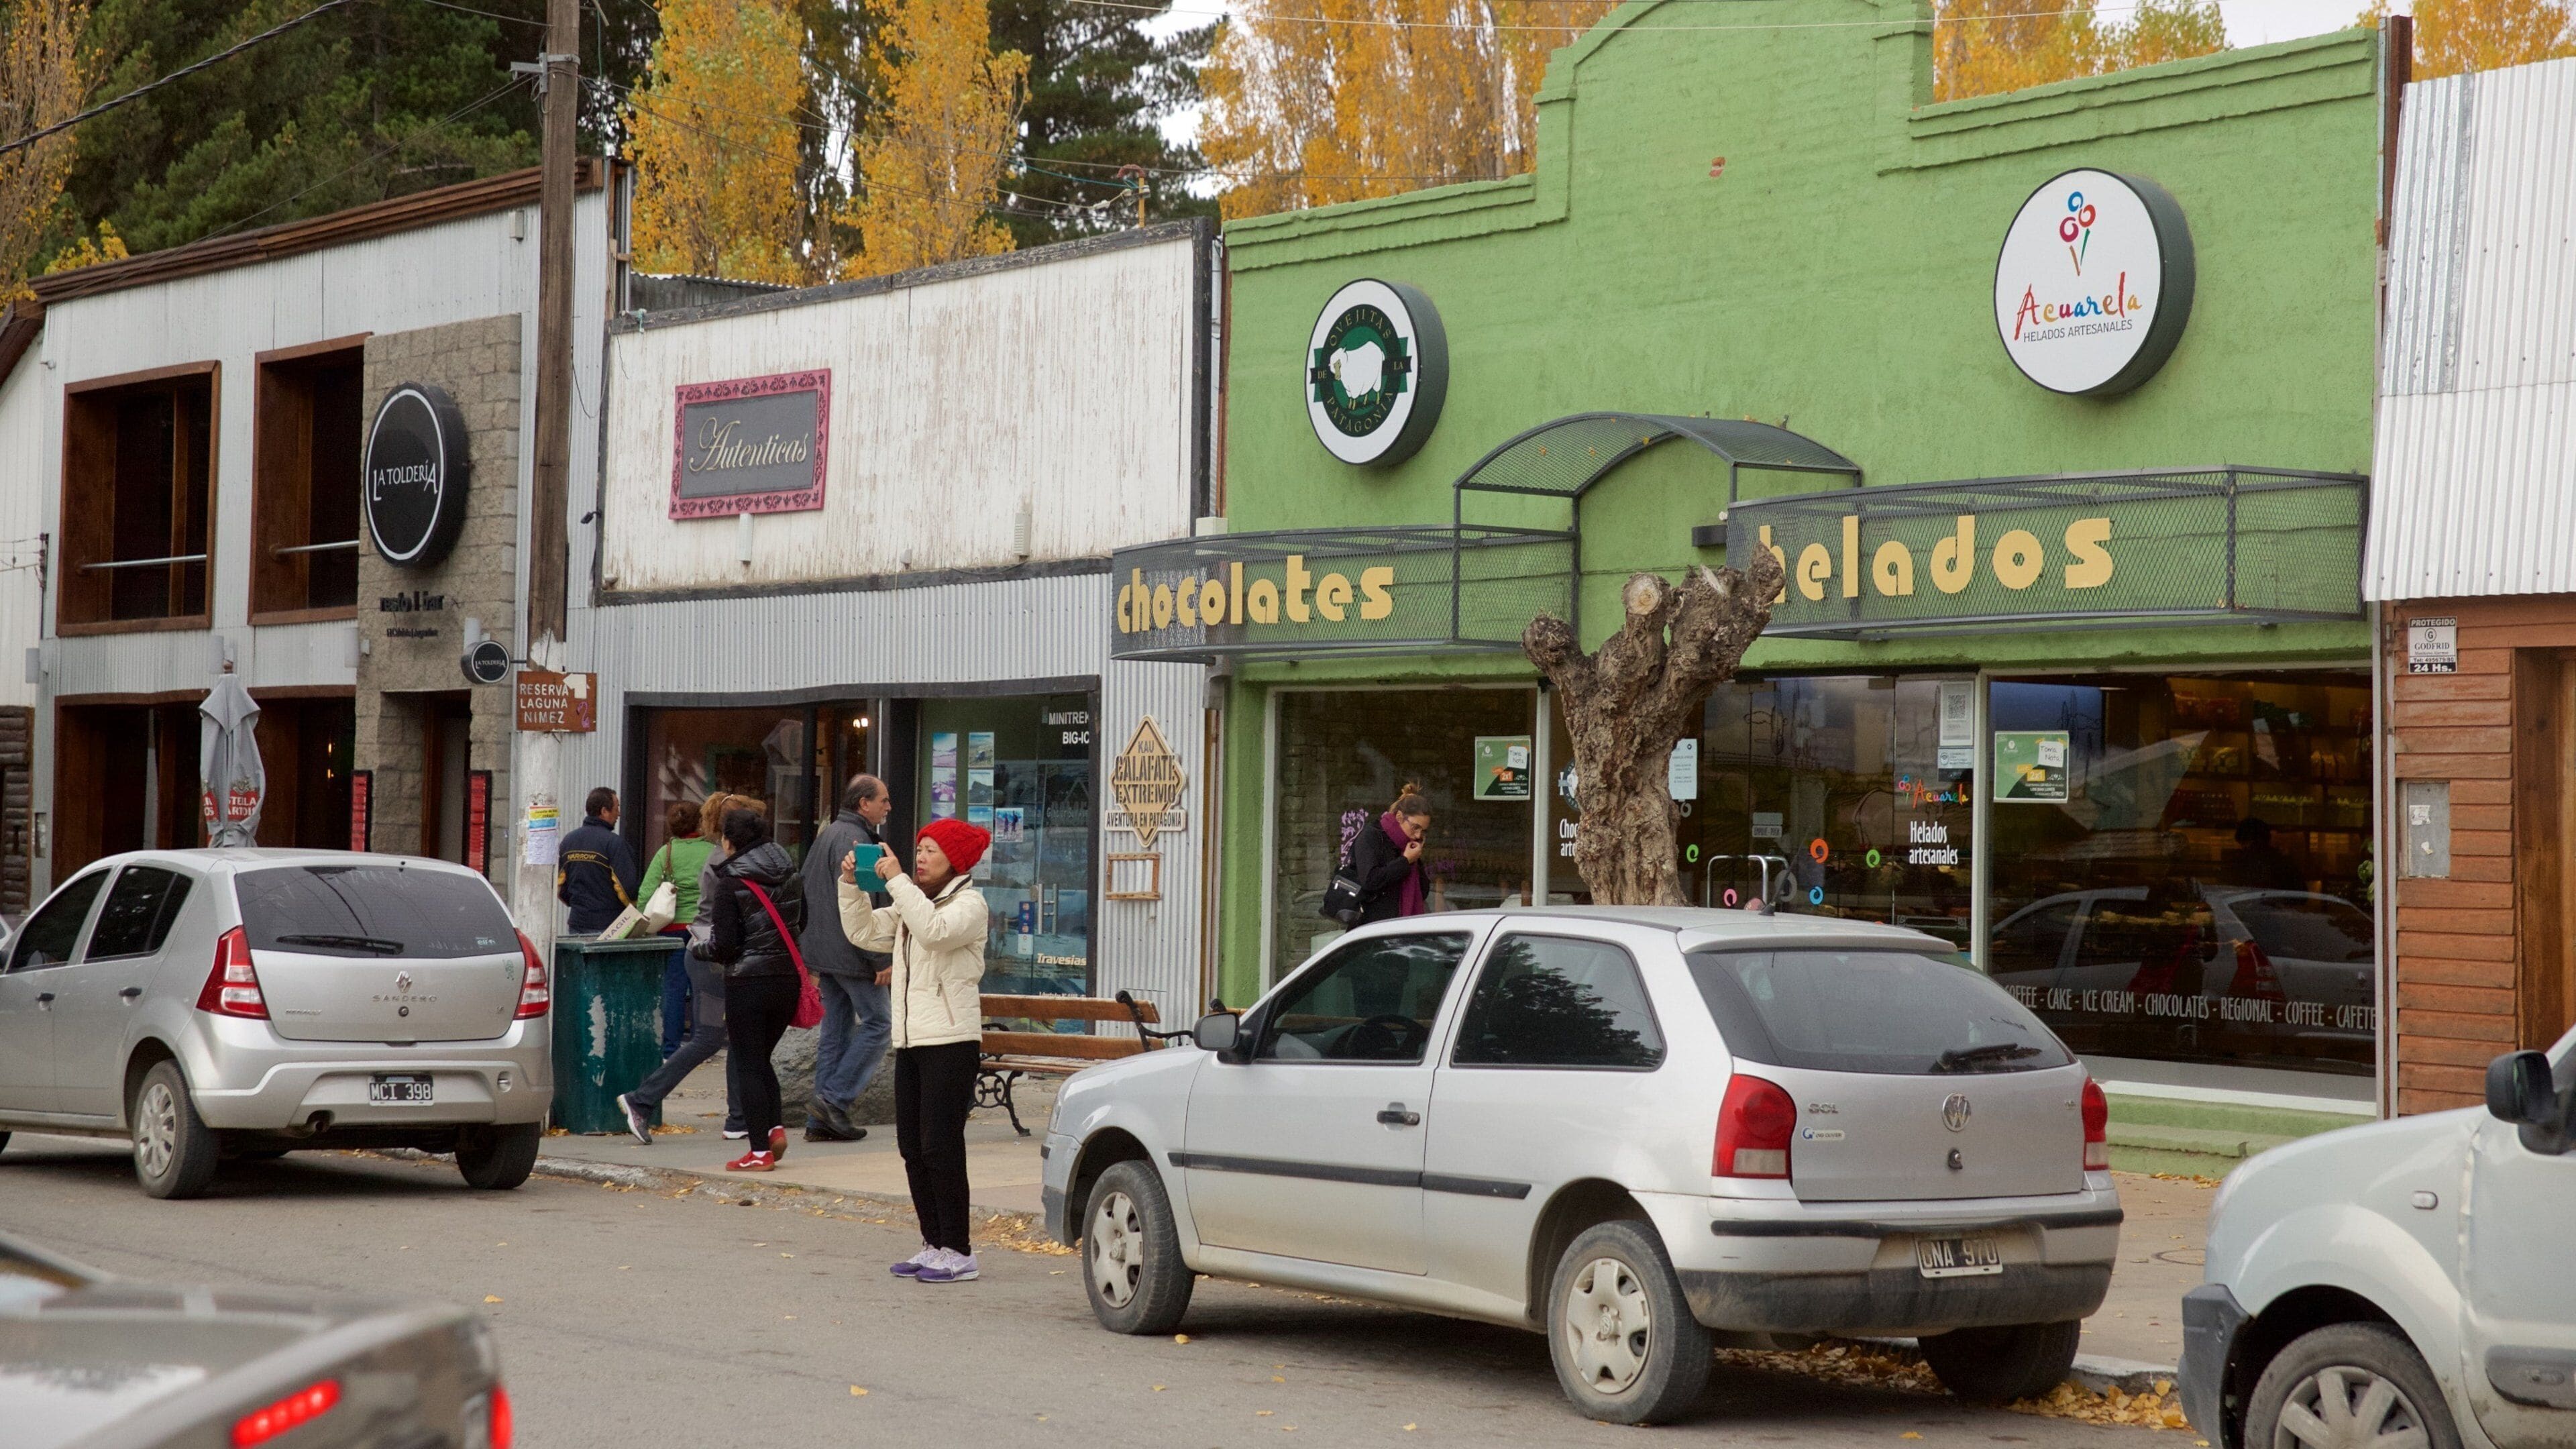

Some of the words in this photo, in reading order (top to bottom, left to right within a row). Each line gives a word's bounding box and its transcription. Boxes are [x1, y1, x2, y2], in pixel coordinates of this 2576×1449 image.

[2015, 272, 2142, 340] Acuarela
[1330, 309, 1393, 346] OVEJITAS
[2023, 328, 2065, 342] HELADOS
[2068, 319, 2133, 337] ARTESANALES
[1318, 370, 1328, 379] DE
[1393, 361, 1404, 370] LA
[1327, 391, 1393, 433] PATAGONIA
[689, 417, 809, 472] Autenticas
[373, 469, 386, 501] LA
[1117, 555, 1394, 634] chocolates
[2414, 663, 2428, 672] 24
[2432, 663, 2453, 672] Hs.
[520, 683, 569, 696] RESERVA
[520, 698, 568, 709] LAGUNA
[523, 711, 565, 724] NIMEZ
[1138, 740, 1155, 753] KAU
[1115, 755, 1175, 782] CALAFATE
[1115, 784, 1176, 804] EXTREMO
[1912, 778, 1969, 809] Acuarela
[1106, 812, 1138, 827] AVENTURA
[1139, 812, 1148, 827] EN
[1149, 811, 1181, 827] PATAGONIA
[1910, 820, 1947, 843] Helados
[567, 852, 596, 860] NARROW
[1909, 844, 1958, 865] artesanales
[1037, 953, 1087, 966] Travesias
[2047, 987, 2072, 1010] CAKE
[2082, 989, 2098, 1012] ICE
[2100, 990, 2135, 1014] CREAM
[2145, 993, 2209, 1020] CHOCOLATES
[2220, 996, 2274, 1023] REGIONAL
[2285, 1001, 2324, 1027] COFFEE
[370, 1083, 398, 1100] MCI
[405, 1083, 431, 1100] 398
